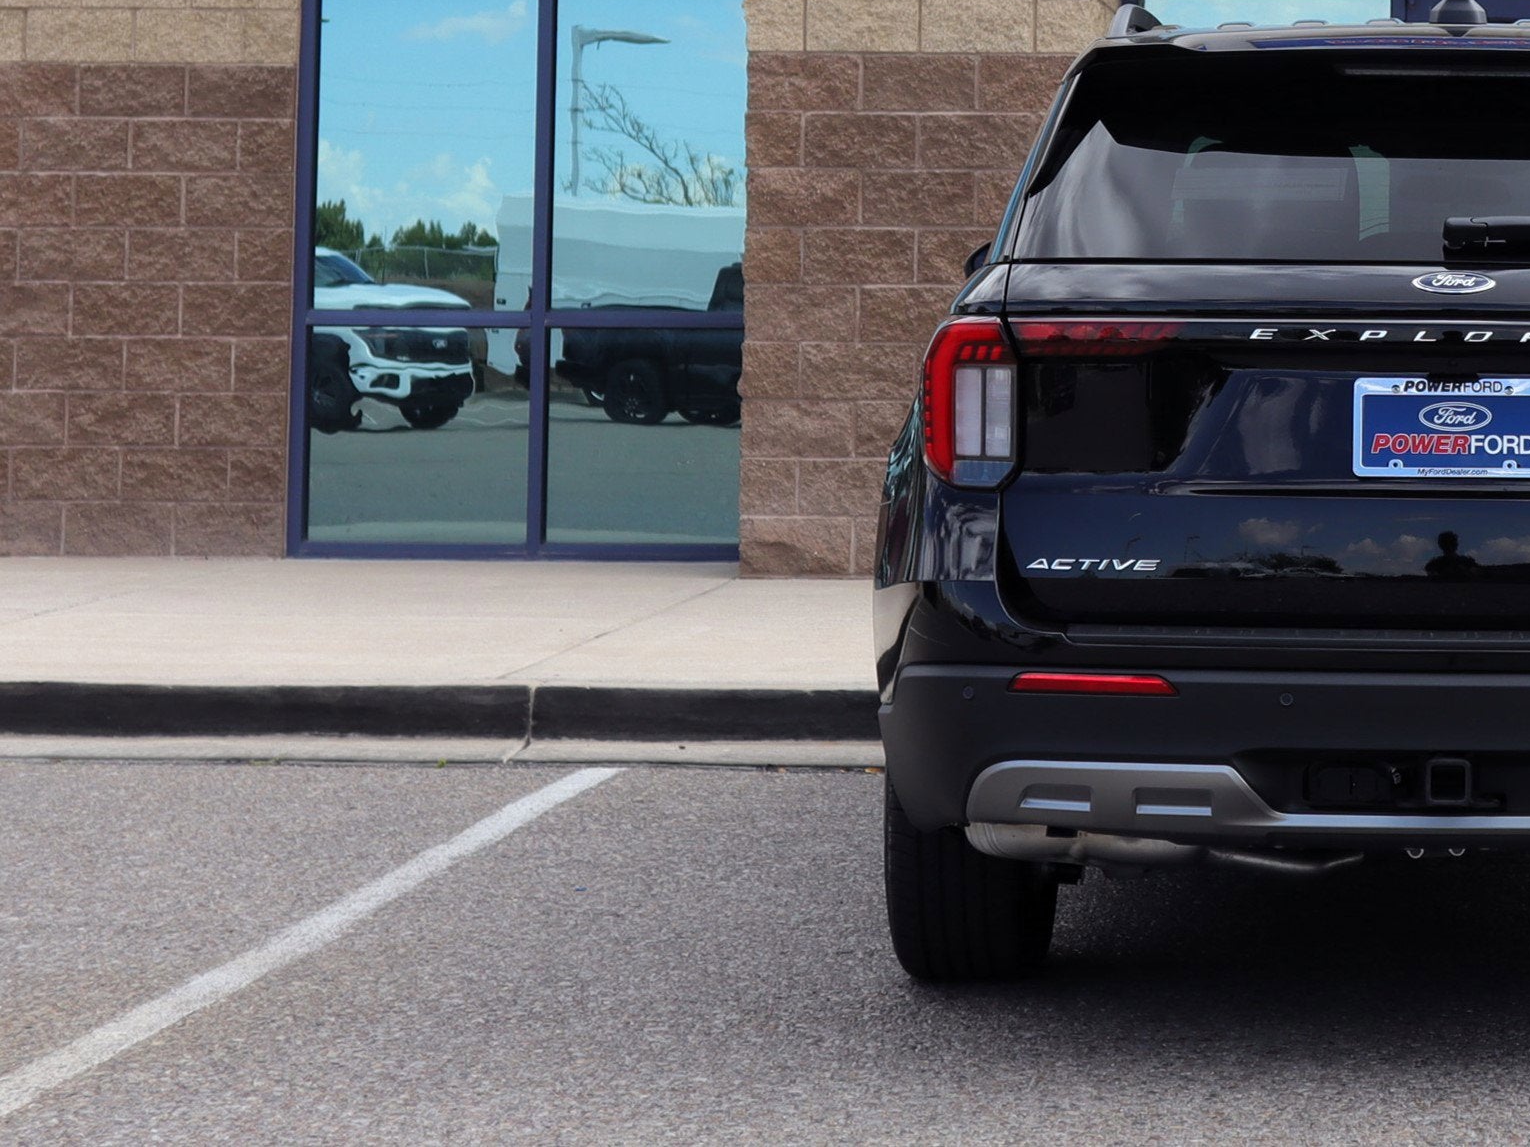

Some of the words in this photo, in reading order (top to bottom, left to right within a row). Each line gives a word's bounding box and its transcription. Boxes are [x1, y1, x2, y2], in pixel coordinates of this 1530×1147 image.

[1431, 273, 1477, 289] Ford
[1403, 379, 1504, 394] POWERFORD
[1433, 406, 1477, 426] Ford
[1025, 558, 1161, 571] ACTIVE
